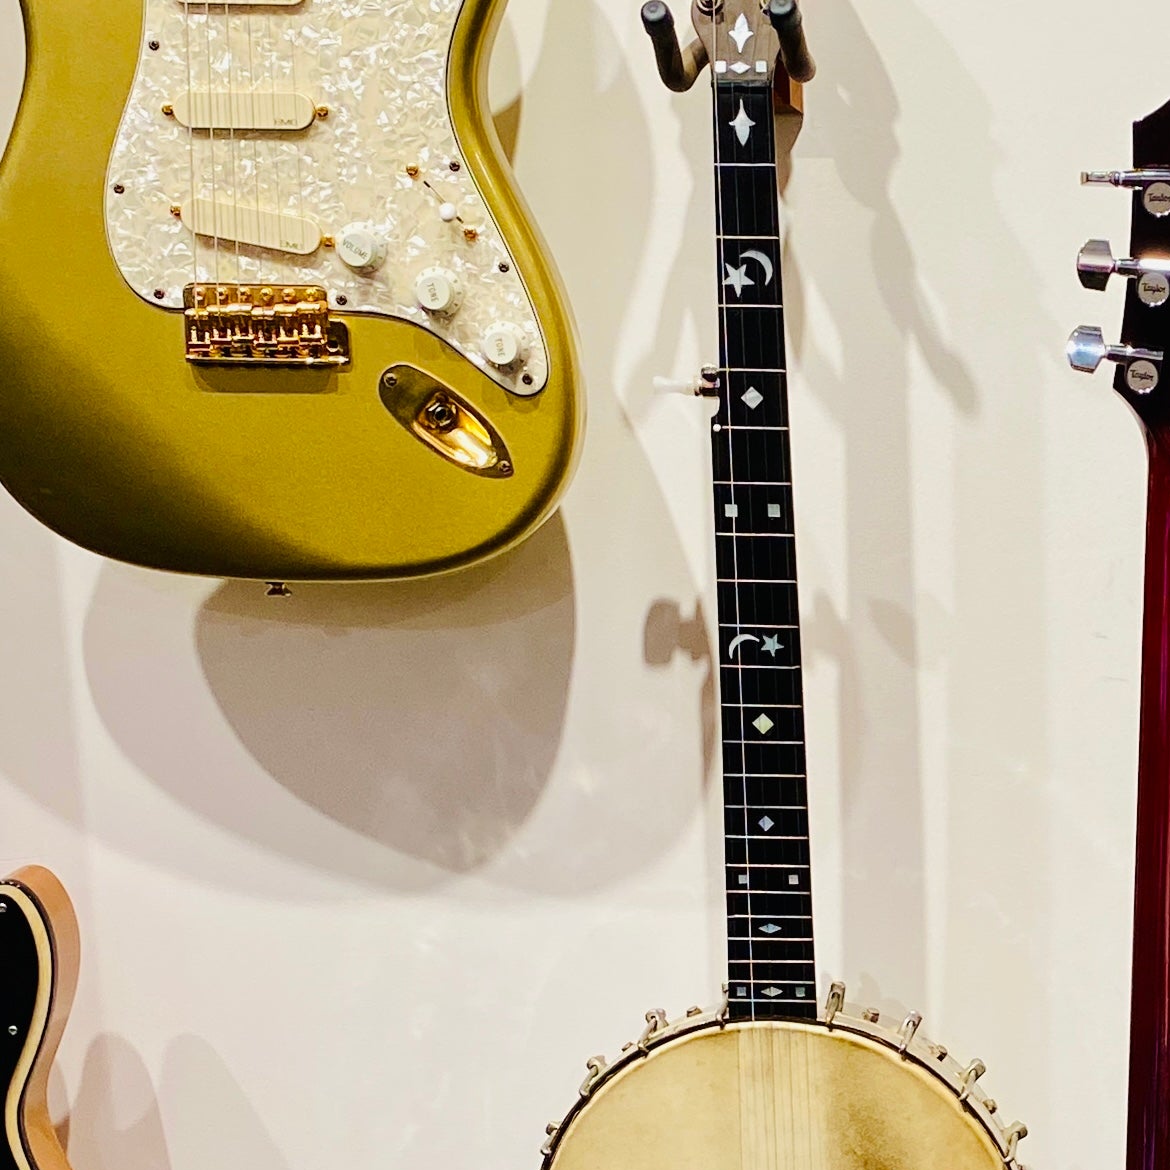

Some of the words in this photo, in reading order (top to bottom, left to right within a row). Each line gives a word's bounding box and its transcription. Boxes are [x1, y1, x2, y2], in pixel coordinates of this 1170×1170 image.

[342, 239, 369, 260] VOLUME
[426, 282, 439, 303] TONE
[1141, 282, 1167, 295] Taylor
[494, 338, 506, 358] TONE
[1129, 369, 1155, 382] Taylor
